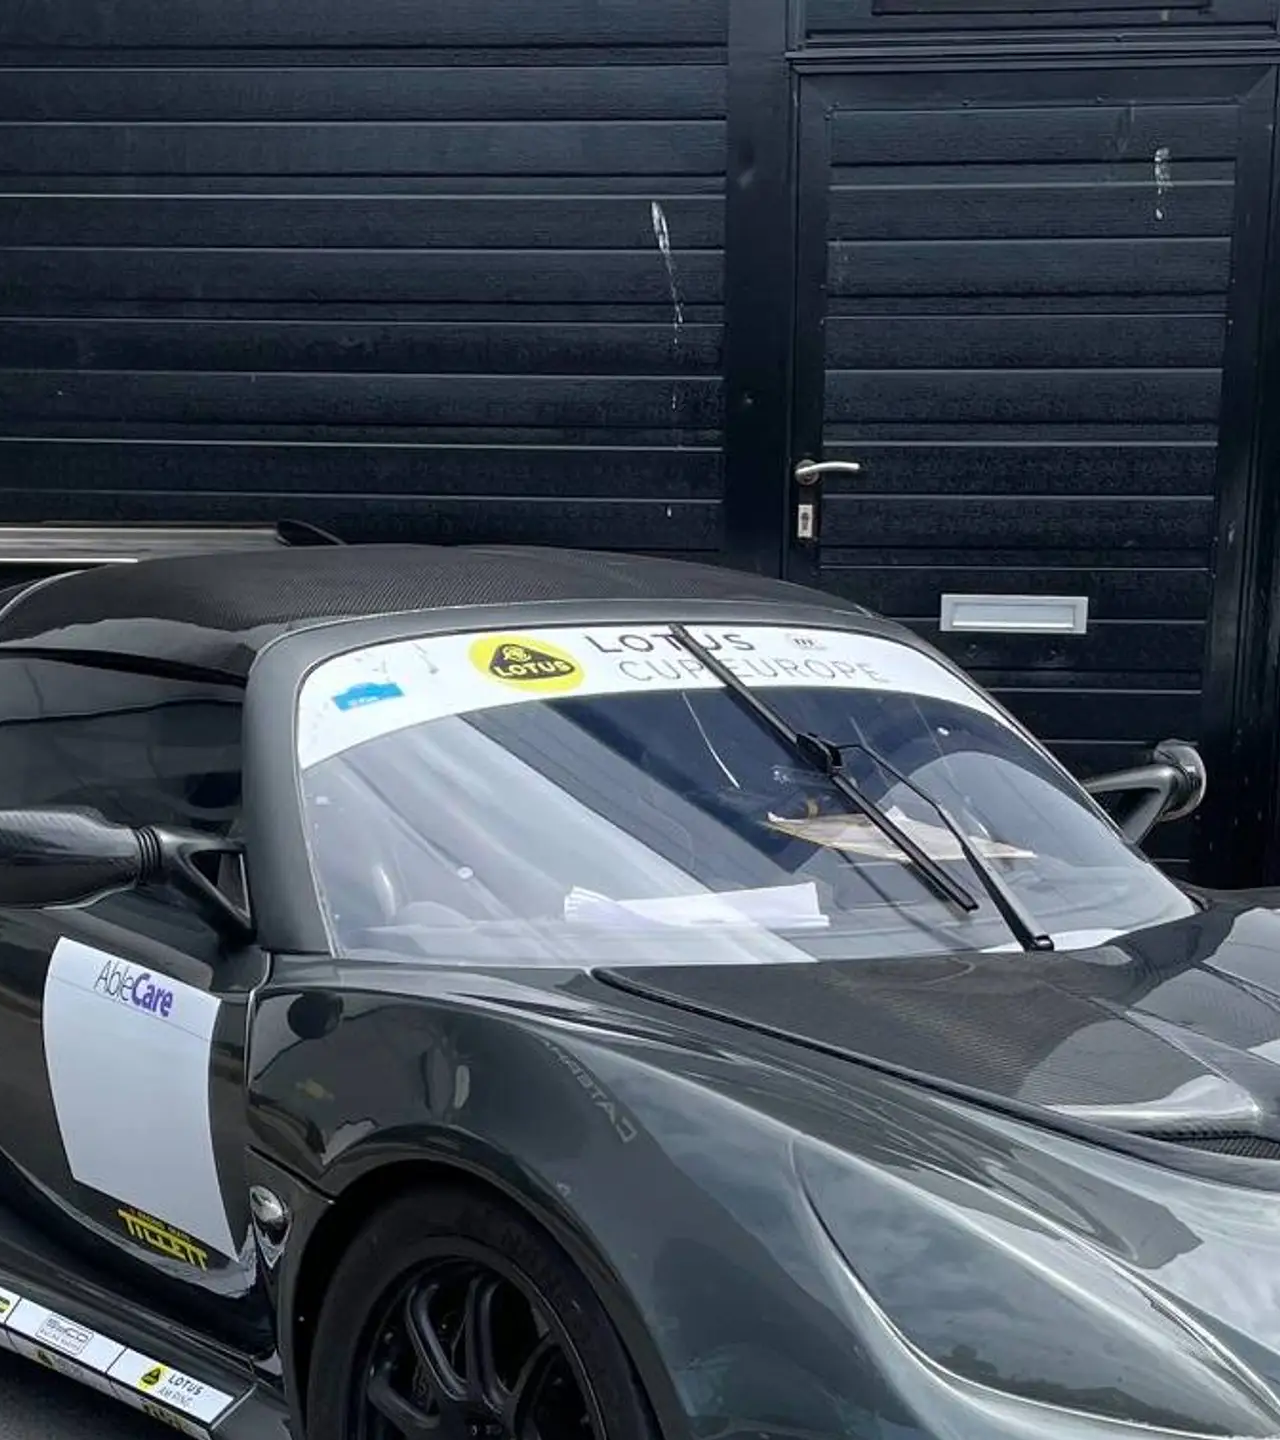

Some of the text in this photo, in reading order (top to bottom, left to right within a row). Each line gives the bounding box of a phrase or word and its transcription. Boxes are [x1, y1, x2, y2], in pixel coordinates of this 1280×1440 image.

[585, 633, 755, 652] LOTUS
[493, 659, 573, 677] LOTUS
[619, 657, 891, 684] CUP EUROPE
[93, 959, 173, 1017] AbleCare
[168, 1373, 205, 1396] LOTUS
